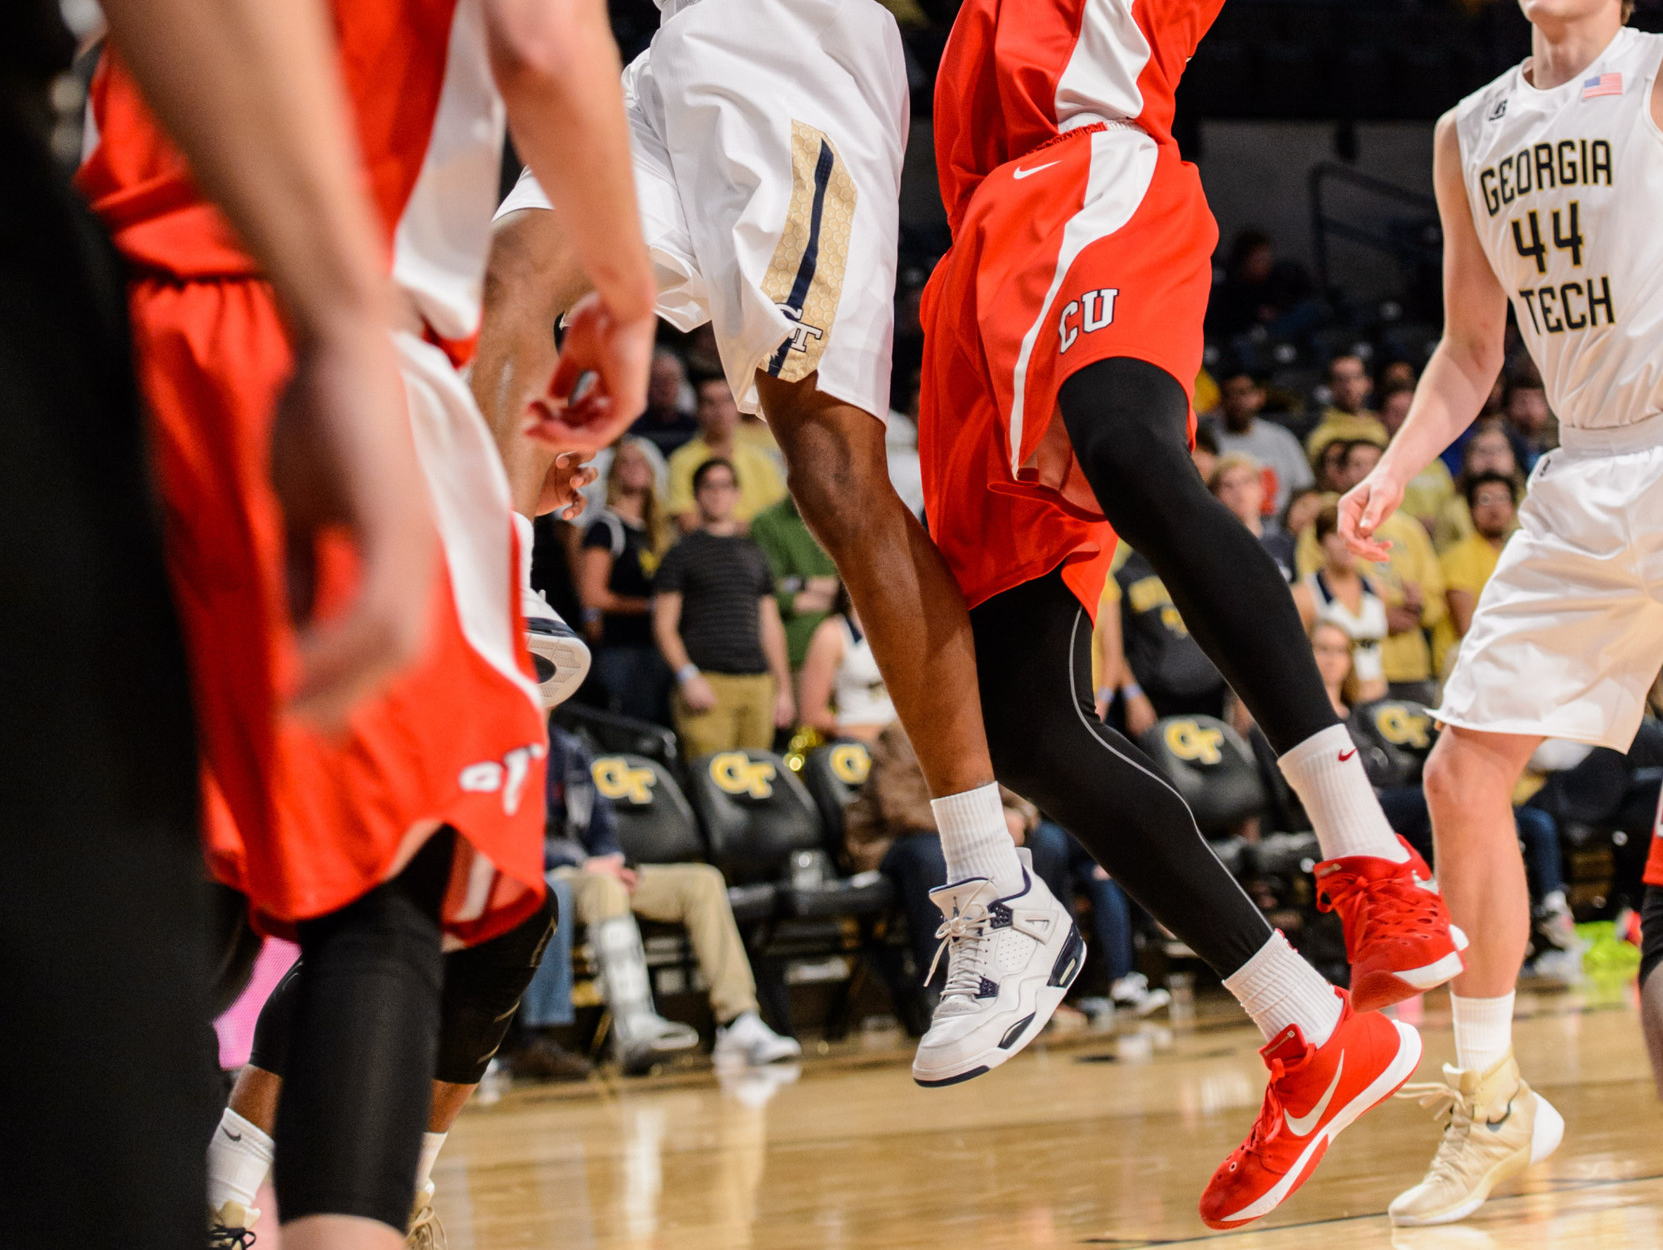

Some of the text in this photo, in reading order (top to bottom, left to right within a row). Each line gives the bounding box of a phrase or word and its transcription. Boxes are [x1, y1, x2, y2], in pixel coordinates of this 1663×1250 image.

[1479, 138, 1615, 217] GEORGIA
[1510, 200, 1585, 275] 44
[1058, 288, 1119, 354] CU
[1518, 275, 1617, 336] TECH
